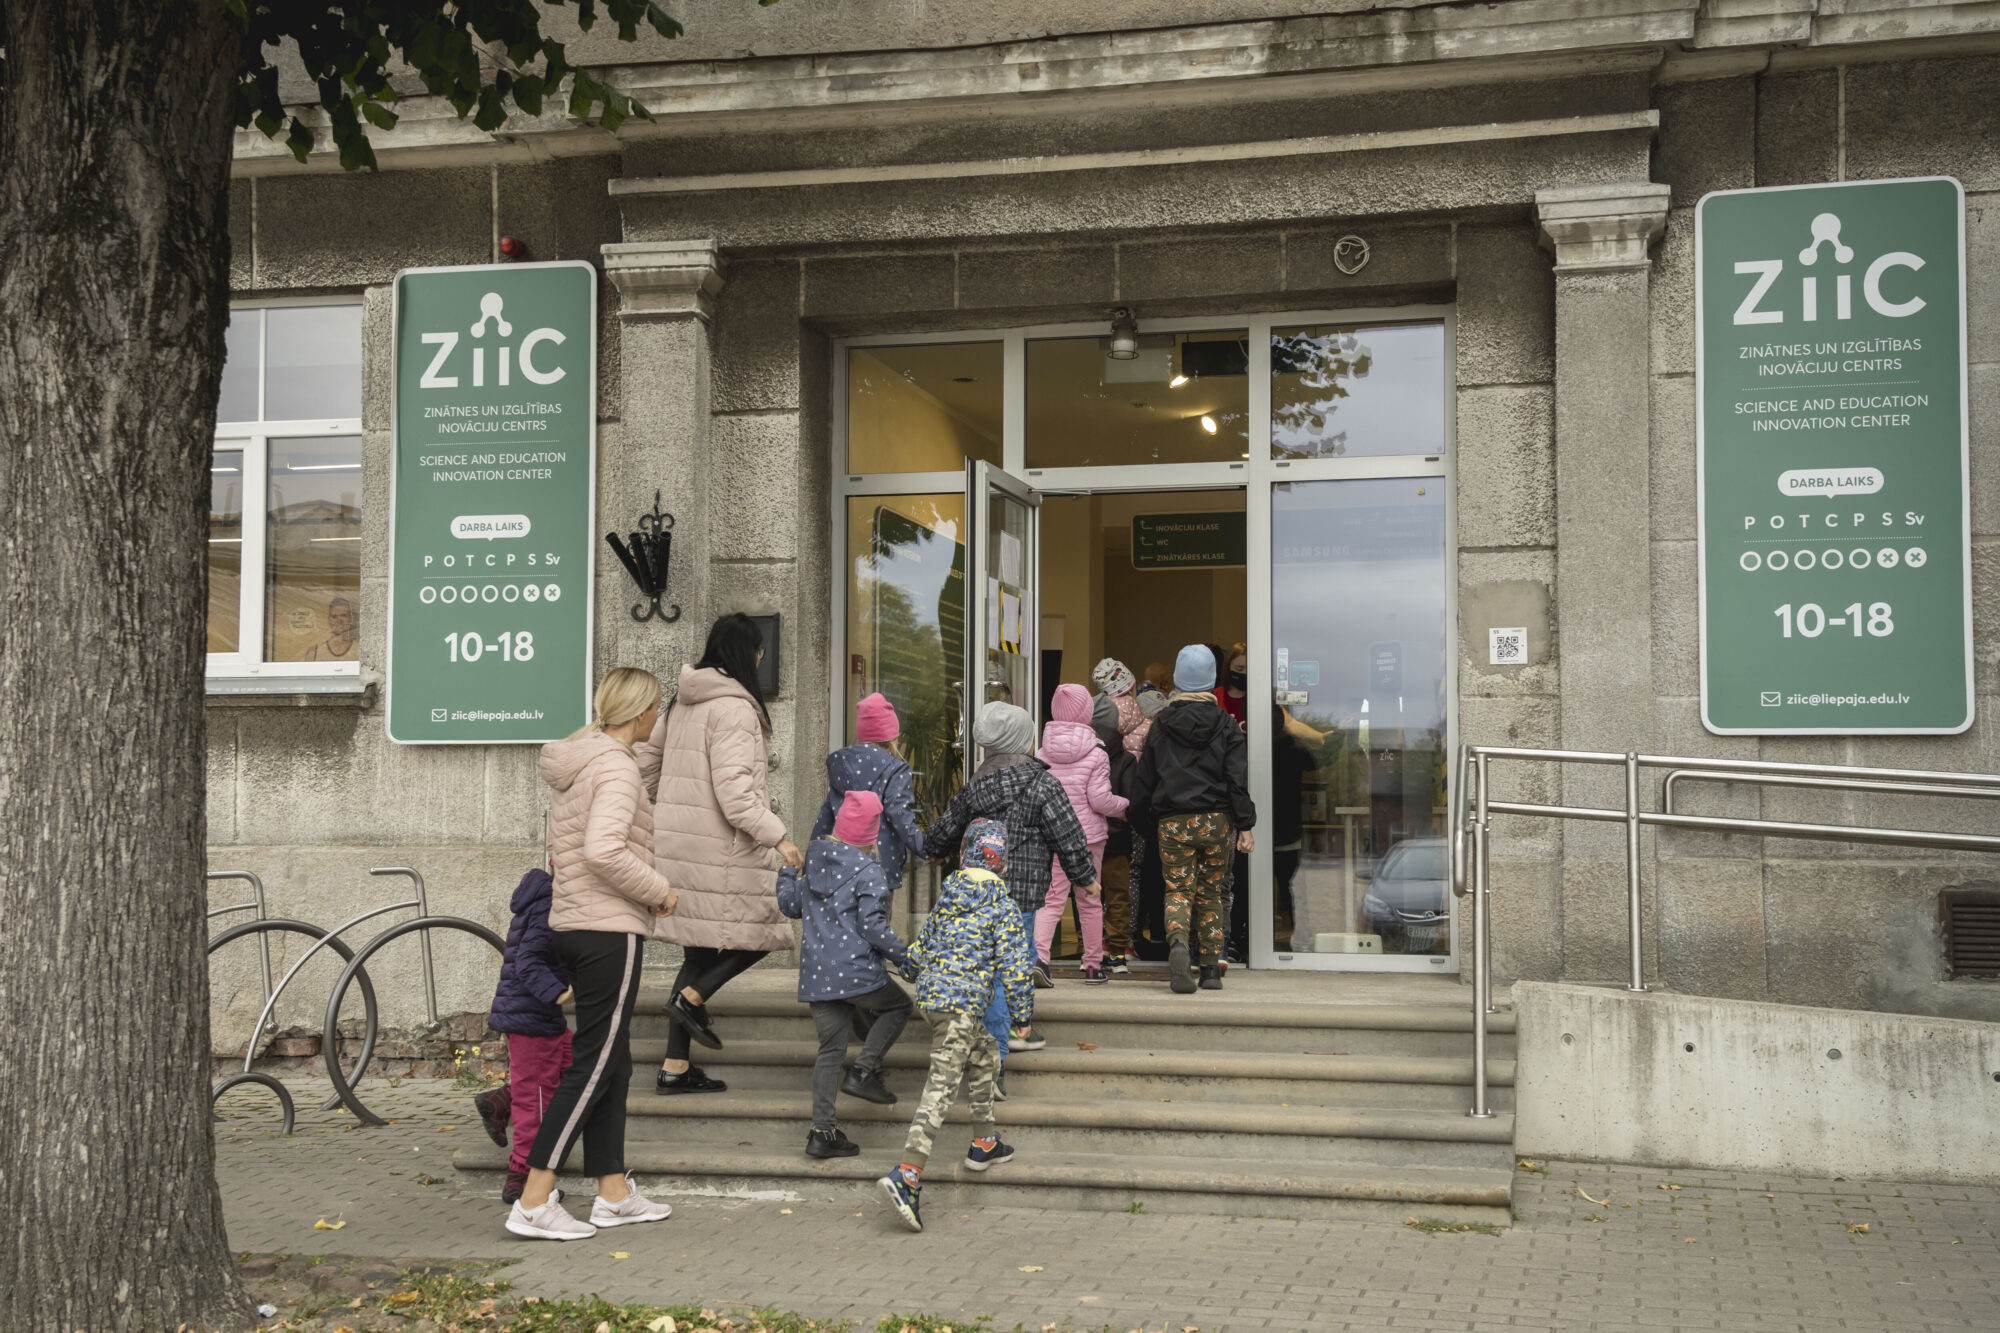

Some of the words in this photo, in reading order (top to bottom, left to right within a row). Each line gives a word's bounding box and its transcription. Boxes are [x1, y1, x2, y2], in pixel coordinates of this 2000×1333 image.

[1739, 343, 1811, 359] ZINĀTNES
[1815, 342, 1837, 355] UN
[1842, 337, 1922, 354] IZGLĪTĪBAS
[1759, 361, 1838, 376] INOVĀCIJU
[1842, 358, 1902, 372] CENTRS
[424, 405, 479, 418] ZINĀTNES
[482, 405, 499, 416] UN
[501, 402, 562, 415] IZGLĪTĪBAS
[1734, 400, 1798, 414] SCIENCE
[1802, 398, 1835, 411] AND
[1839, 395, 1929, 410] EDUCATION
[438, 421, 499, 434] INOVĀCIJU
[501, 420, 547, 432] CENTRS
[1753, 416, 1846, 431] INNOVATION
[1850, 414, 1910, 427] CENTER
[419, 455, 468, 466] SCIENCE
[471, 454, 496, 465] AND
[499, 452, 566, 464] EDUCATION
[433, 470, 504, 482] INNOVATION
[506, 469, 552, 480] CENTER
[1789, 477, 1833, 489] DARBA
[1837, 476, 1874, 487] LAIKS
[459, 522, 493, 532] DARBA
[495, 522, 524, 532] LAIKS
[1744, 516, 1755, 530] P
[1770, 515, 1785, 529] O
[1799, 514, 1810, 528] T
[1825, 513, 1838, 527] C
[1853, 513, 1865, 526] P
[1882, 512, 1893, 526] S
[1905, 511, 1925, 525] Sv
[424, 555, 433, 567] P
[443, 555, 455, 567] O
[466, 555, 474, 566] T
[485, 554, 496, 566] C
[507, 554, 516, 566] P
[528, 554, 537, 566] S
[545, 553, 561, 565] Sv
[1774, 602, 1894, 638] 10-18
[444, 631, 535, 662] 10-18
[1786, 693, 1910, 707] ziic@liepaja.edu.lv
[451, 710, 544, 722] ziic@liepaja.edu.lv
